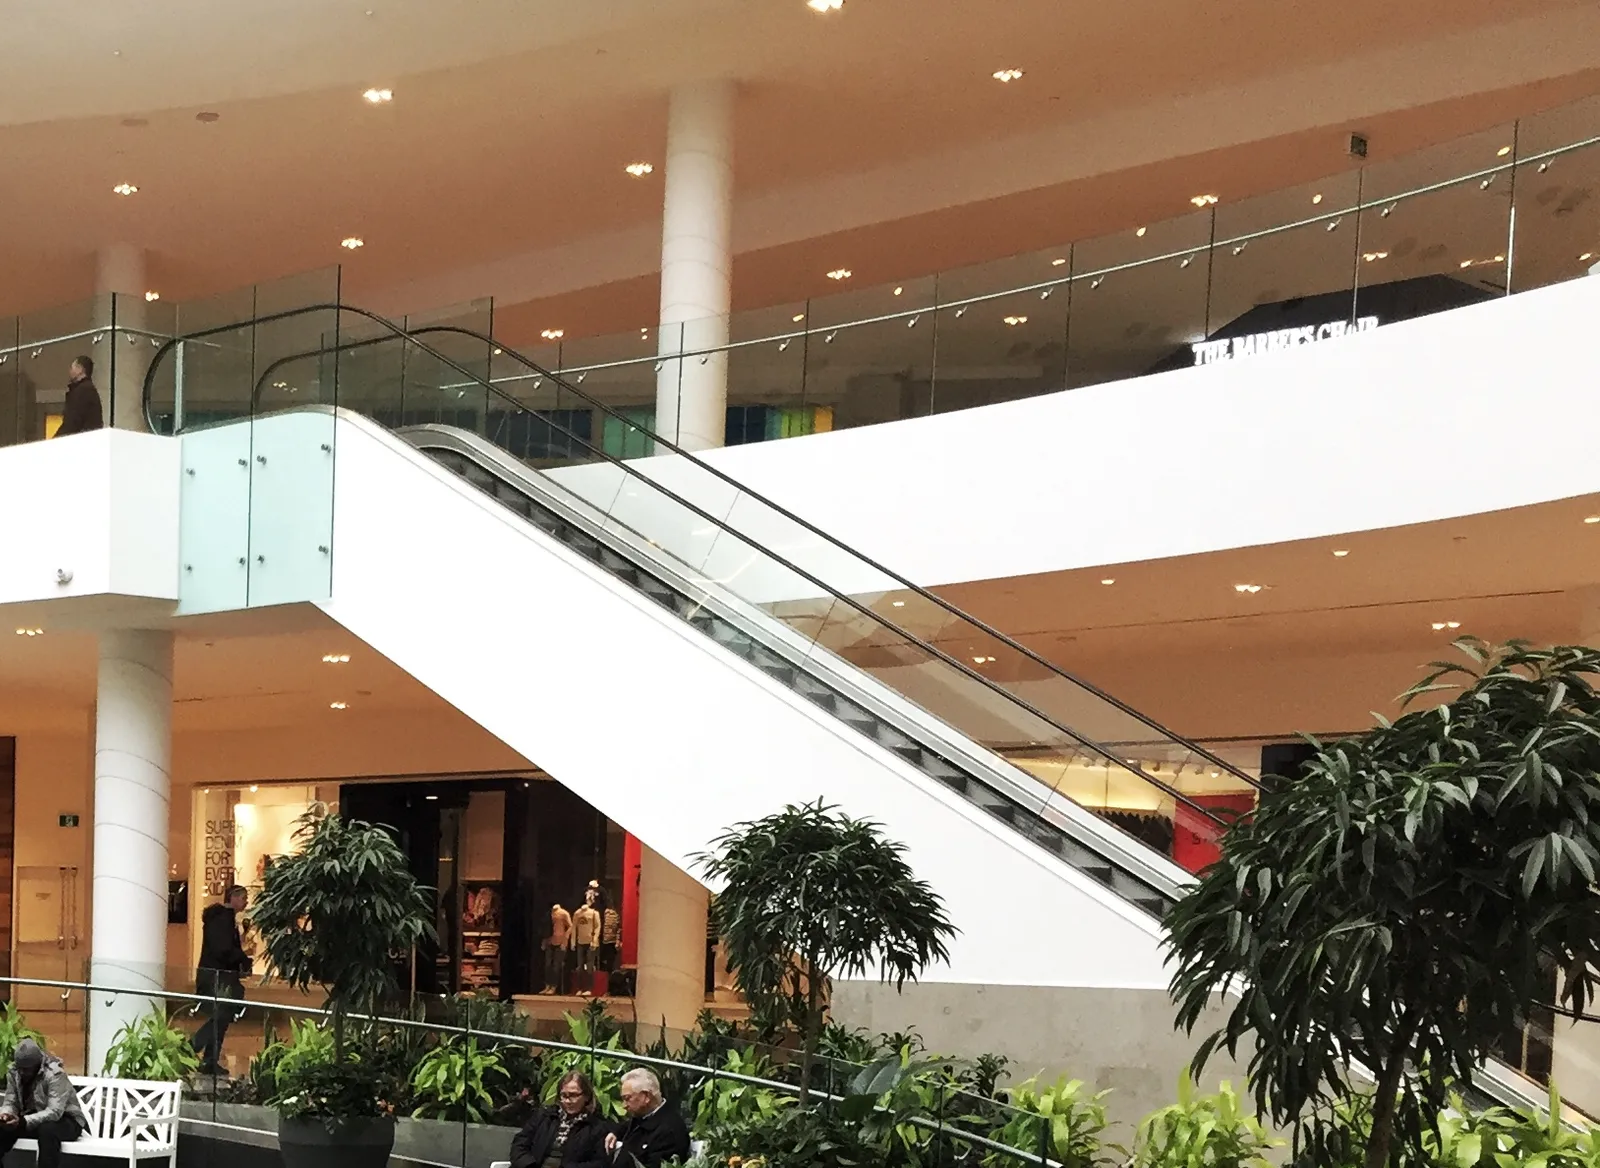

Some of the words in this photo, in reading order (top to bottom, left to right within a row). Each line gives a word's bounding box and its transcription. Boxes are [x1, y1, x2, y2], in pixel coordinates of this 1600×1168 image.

[205, 820, 244, 835] SUPER
[205, 851, 231, 865] FOR
[205, 867, 242, 881] EVERY
